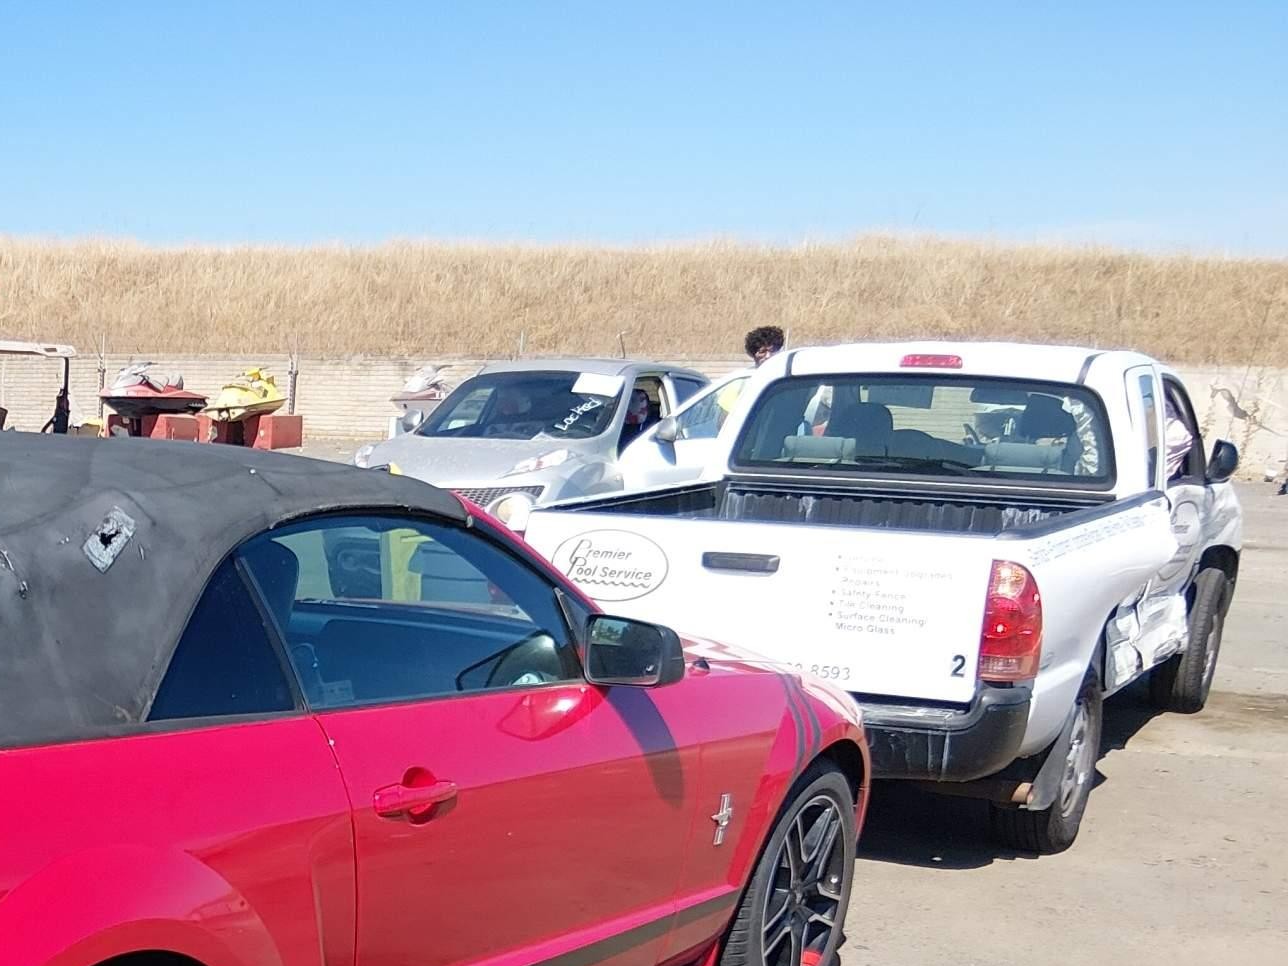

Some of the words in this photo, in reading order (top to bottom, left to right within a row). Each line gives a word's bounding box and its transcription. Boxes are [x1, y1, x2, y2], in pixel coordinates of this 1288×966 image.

[569, 539, 632, 564] Premier
[566, 556, 598, 577] Pool
[600, 566, 652, 581] Service
[838, 610, 875, 622] Surface
[859, 601, 904, 614] Cleaning
[835, 622, 863, 633] Micro
[866, 624, 895, 635] Glass
[950, 654, 967, 678] 2
